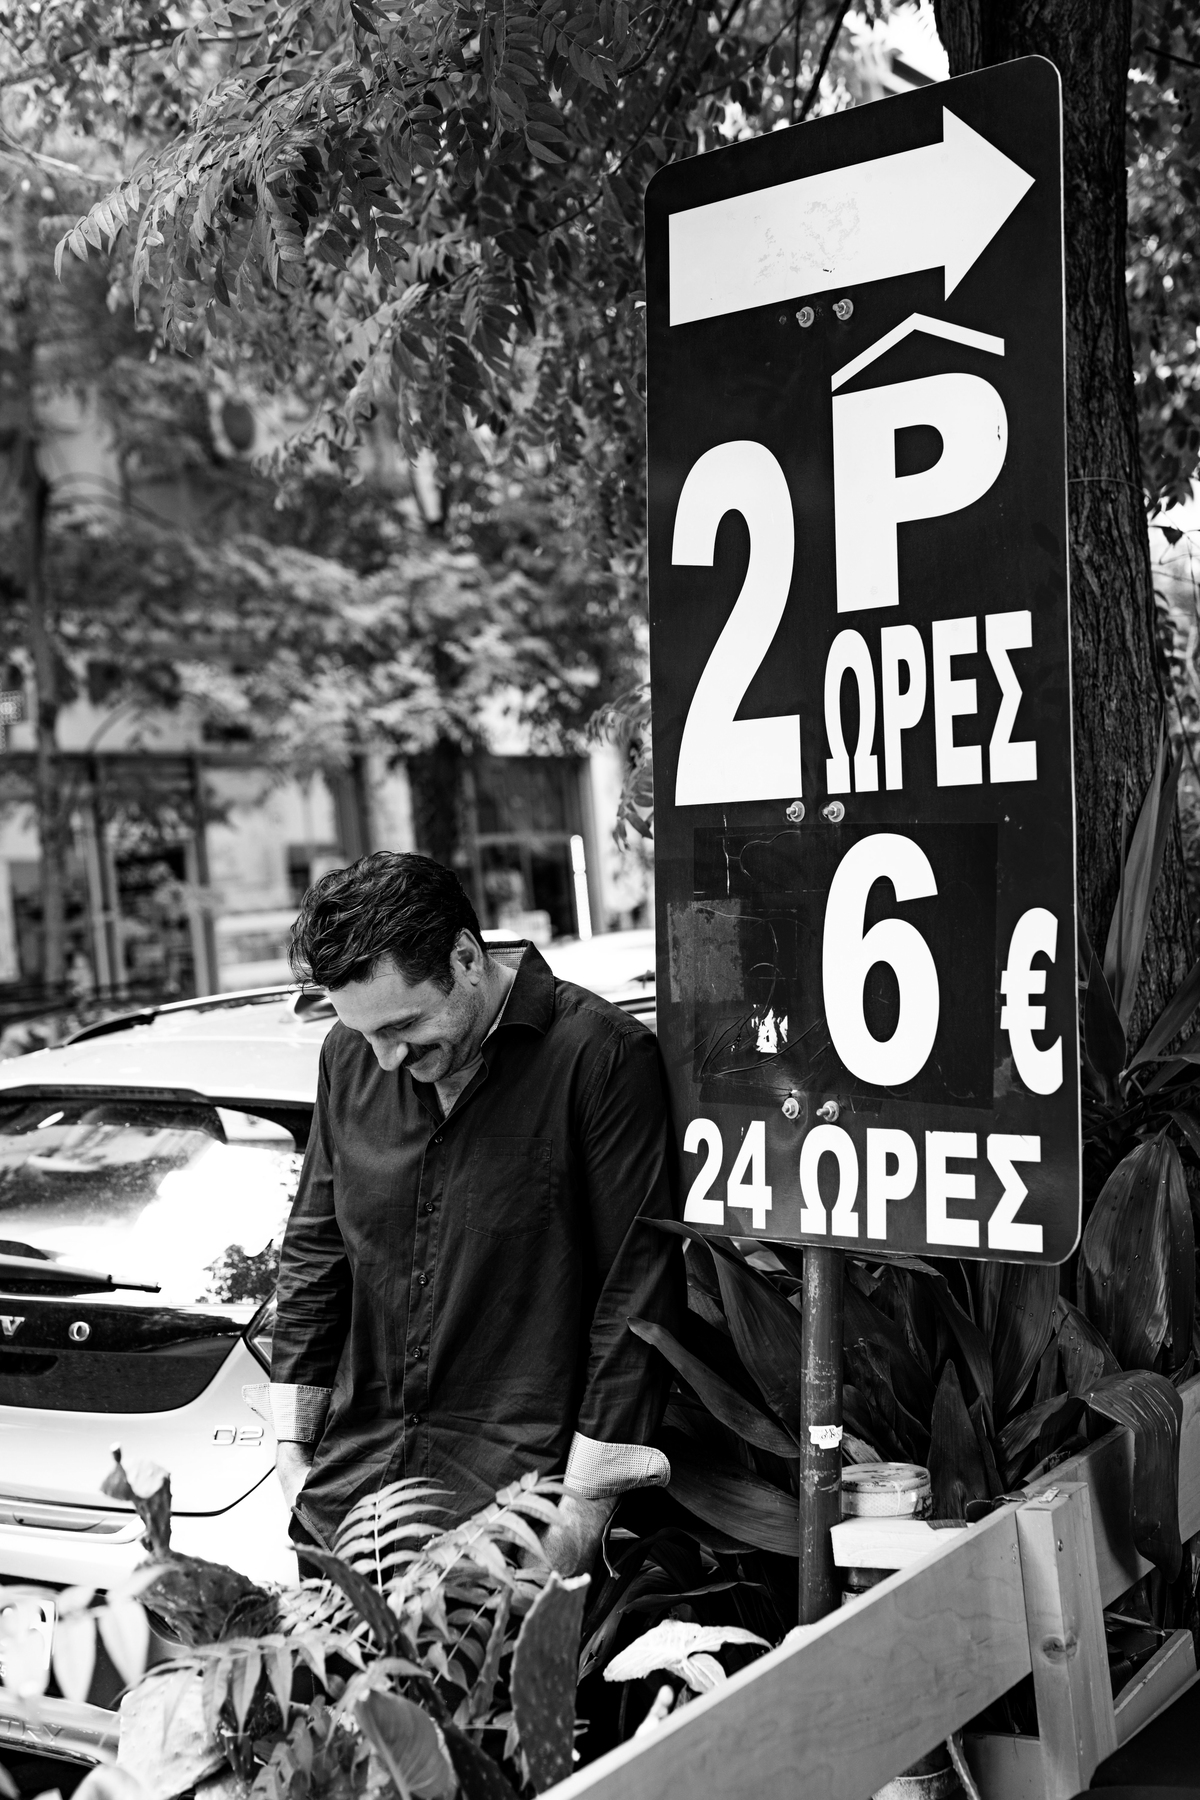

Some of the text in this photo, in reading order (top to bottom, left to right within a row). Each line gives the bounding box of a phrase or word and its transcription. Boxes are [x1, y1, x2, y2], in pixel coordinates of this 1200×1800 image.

[832, 372, 1008, 614] P
[671, 440, 1038, 807] 2 ΩΡΕΣ
[822, 832, 1064, 1095] 6 €
[683, 1117, 1044, 1253] 24 ΩΡΕΣ
[212, 1425, 264, 1446] D2
